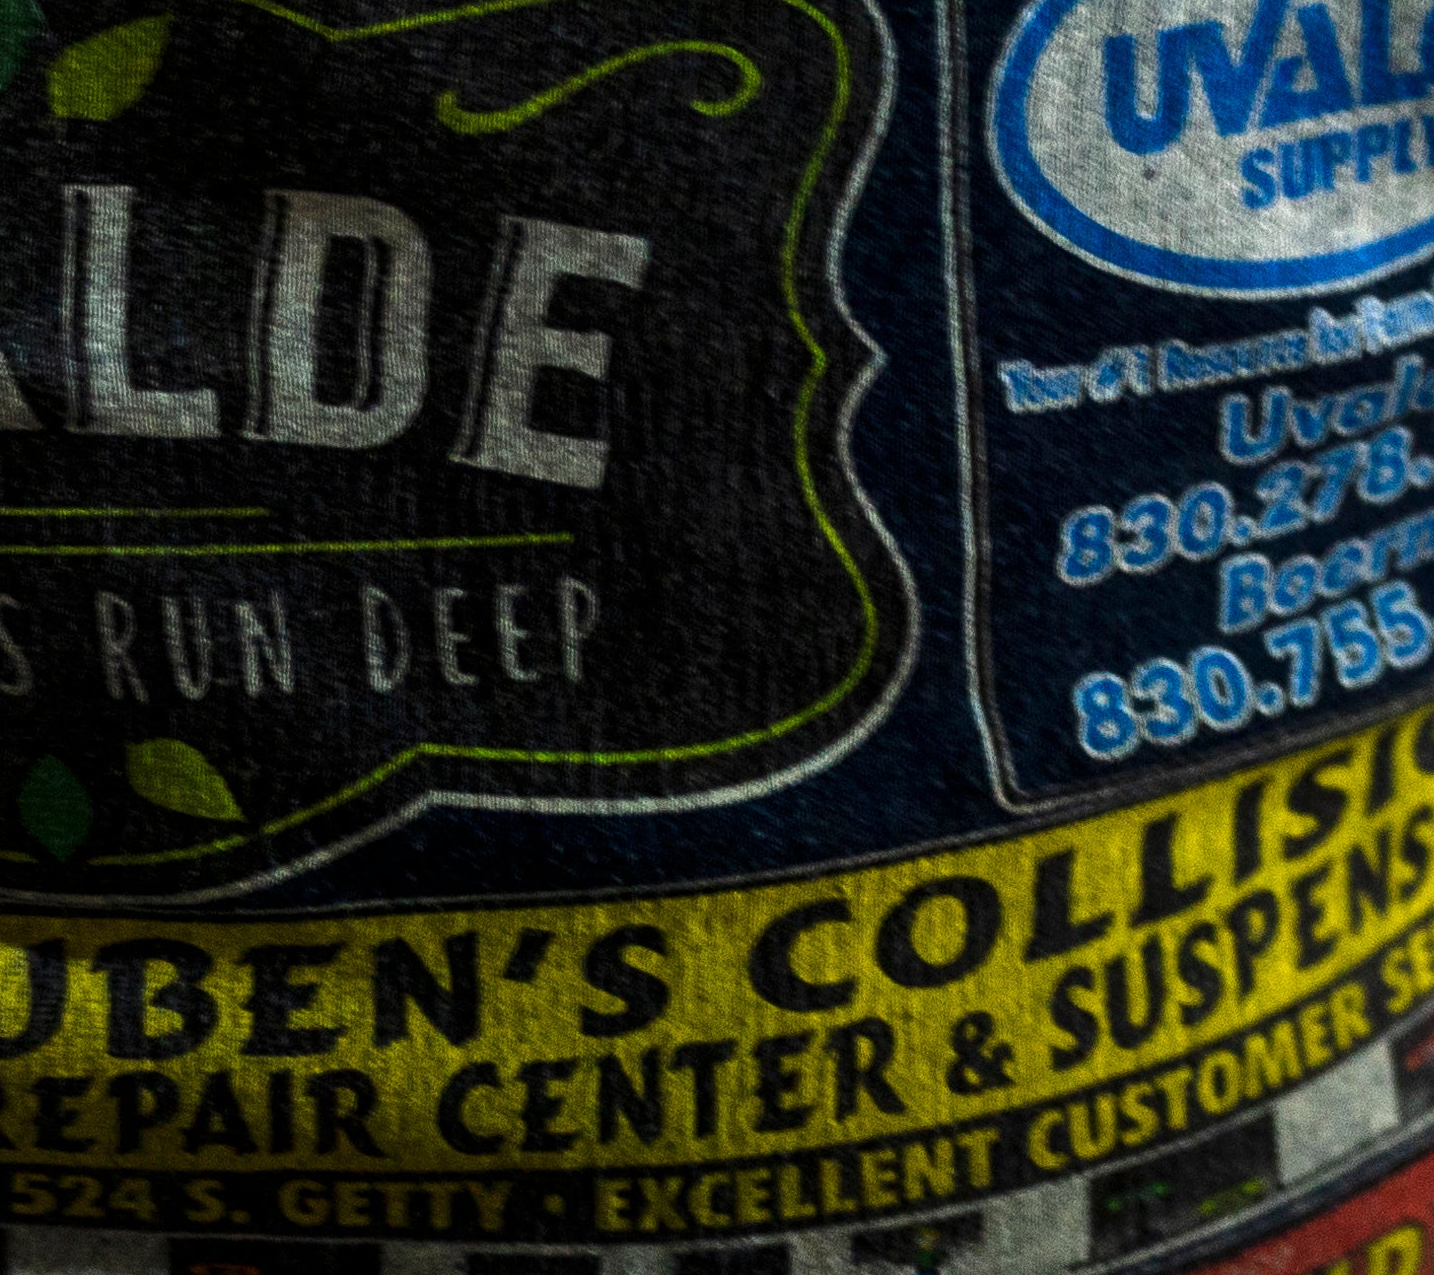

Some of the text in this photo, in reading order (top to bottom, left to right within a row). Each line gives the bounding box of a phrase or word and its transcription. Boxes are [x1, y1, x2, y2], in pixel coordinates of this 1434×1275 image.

[92, 579, 300, 706] RUN
[358, 571, 604, 695] DEEP
[8, 1171, 164, 1223] 524
[188, 1181, 254, 1227] S.
[274, 1175, 518, 1237] GETTY
[592, 1126, 1000, 1237] EXCELLENT
[1026, 981, 1375, 1173] CUSTOMER
[437, 1016, 907, 1155] CENTER
[944, 1011, 1017, 1096] &
